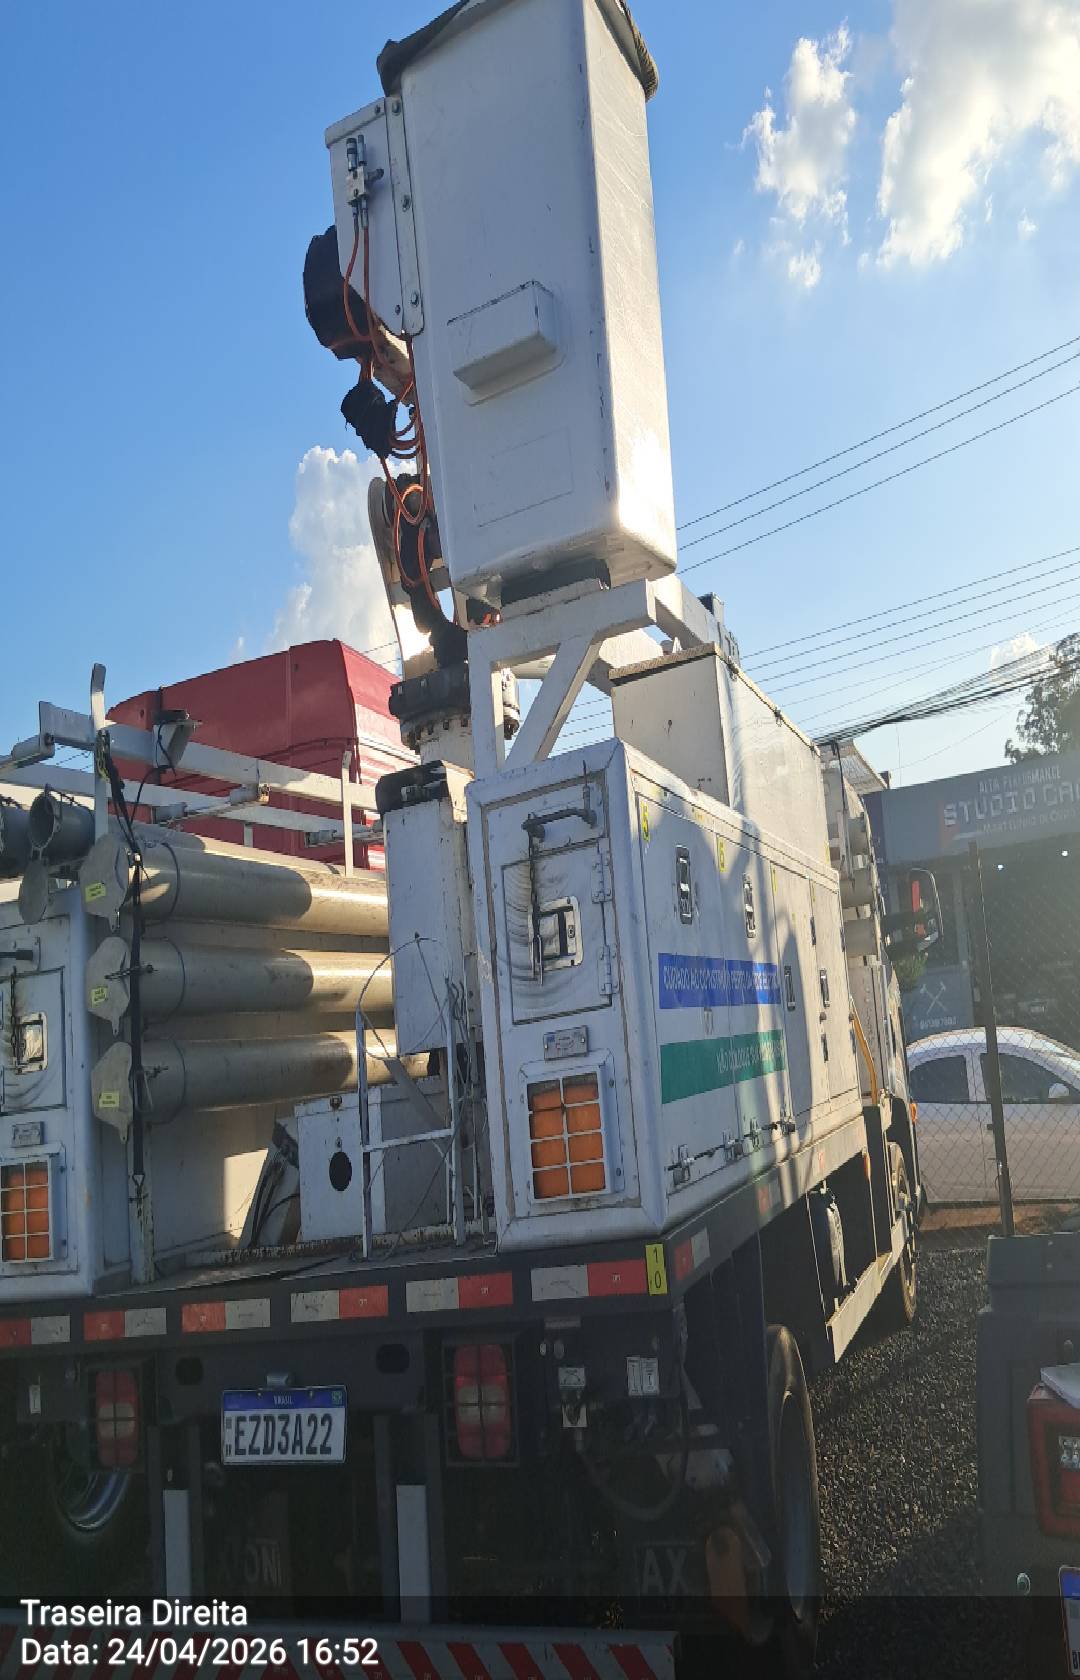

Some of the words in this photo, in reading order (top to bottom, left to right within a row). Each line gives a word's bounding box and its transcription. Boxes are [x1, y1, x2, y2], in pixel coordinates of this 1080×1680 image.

[943, 787, 1036, 827] STUDIO
[1042, 778, 1080, 807] CA
[234, 1412, 333, 1456] EZD3A22
